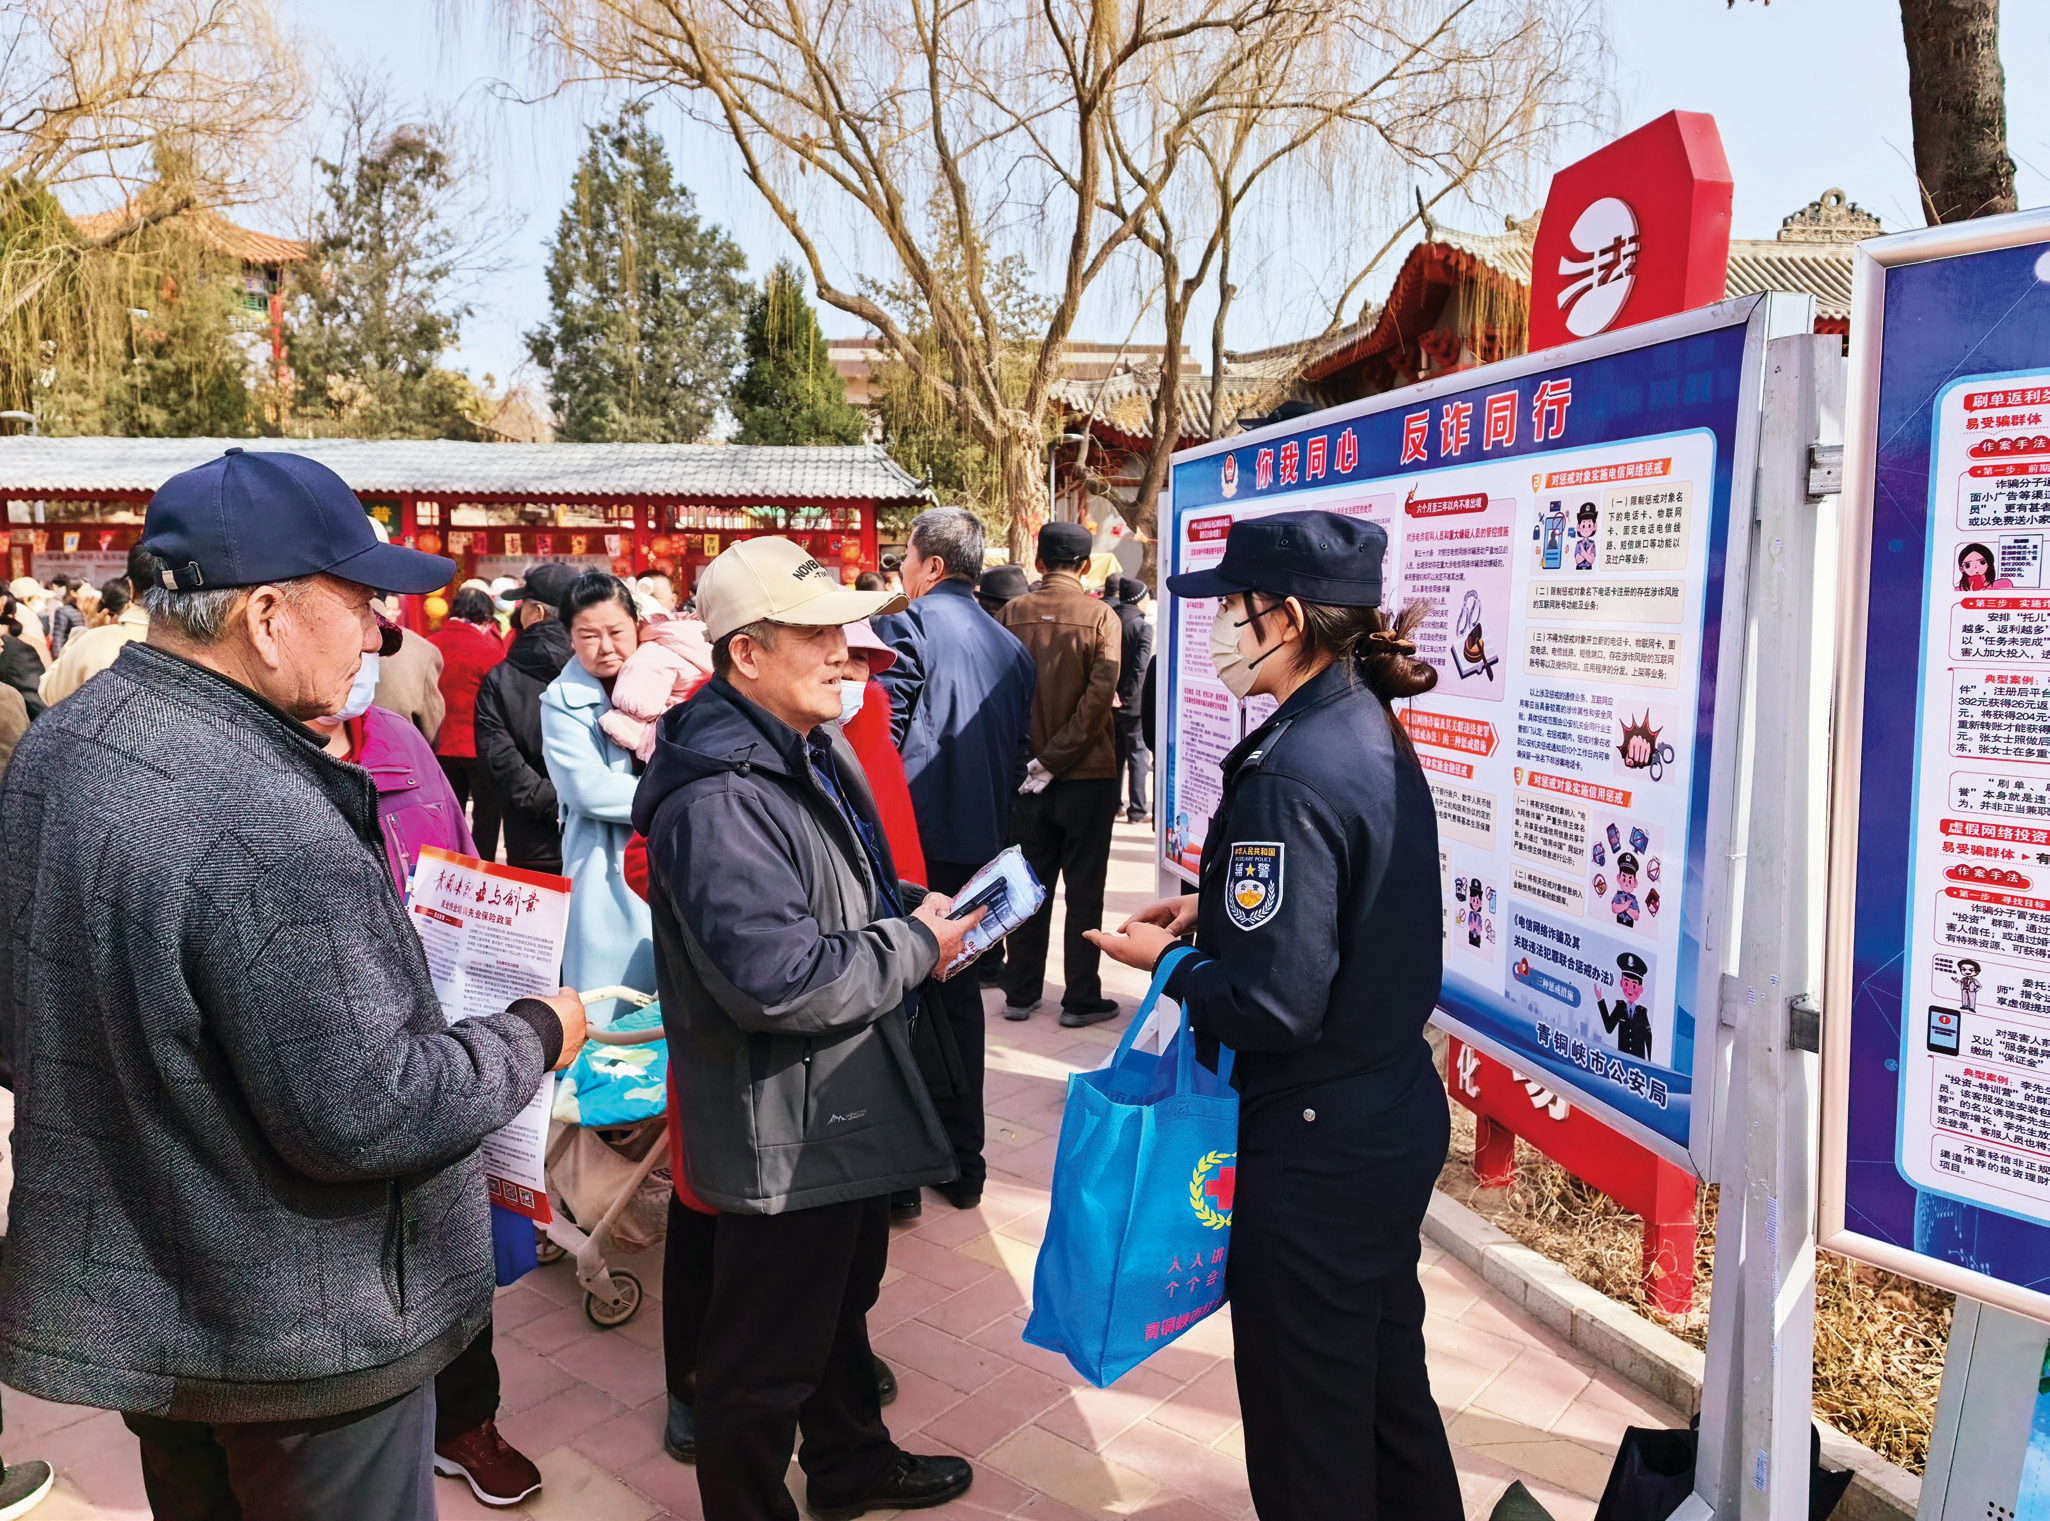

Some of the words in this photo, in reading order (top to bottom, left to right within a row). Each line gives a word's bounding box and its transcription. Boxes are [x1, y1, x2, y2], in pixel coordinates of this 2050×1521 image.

[1966, 413, 2042, 431] 易受骗群体
[1255, 427, 1359, 490] 你我同心
[1400, 378, 1573, 466] 反诈同行
[1981, 438, 2046, 452] 作案手法
[1551, 461, 1663, 486] 对惩戒对象实施电信网络惩戒
[1611, 492, 1683, 508] （一）限制惩戒对象名
[1608, 507, 1682, 522] 下的电话卡、物联网
[1607, 522, 1682, 536] 卡、固定电话电信线
[1606, 537, 1680, 551] 路、短信端口等功能以
[1958, 708, 2050, 722] 元，将获得204元
[1956, 743, 2050, 758] 冻，张女士在多重
[1418, 755, 1468, 777] 对象实施金融惩戒
[1533, 774, 1624, 805] 对惩戒对象实施信用惩戒
[1958, 787, 2050, 804] 誉”本身就是违
[1948, 822, 2048, 843] 虚假网络投资
[1942, 841, 2015, 860] 易受骗群体
[1257, 862, 1271, 878] 警
[1958, 867, 2019, 883] 作案手法
[1514, 913, 1580, 950] 《电信网络诈骗及其
[1945, 934, 2050, 958] 有特殊资源、可获得
[1514, 935, 1615, 987] 关联违法犯罪联合惩戒办法》
[2022, 978, 2050, 992] 委托
[1535, 1021, 1668, 1110] 青铜峡市公安局
[1937, 1116, 2050, 1151] 法登录，客服人员也将
[1940, 1160, 1966, 1174] 项目。
[1940, 1149, 2049, 1186] 渠道推荐的投资理财
[1165, 1268, 1227, 1299] 个个会
